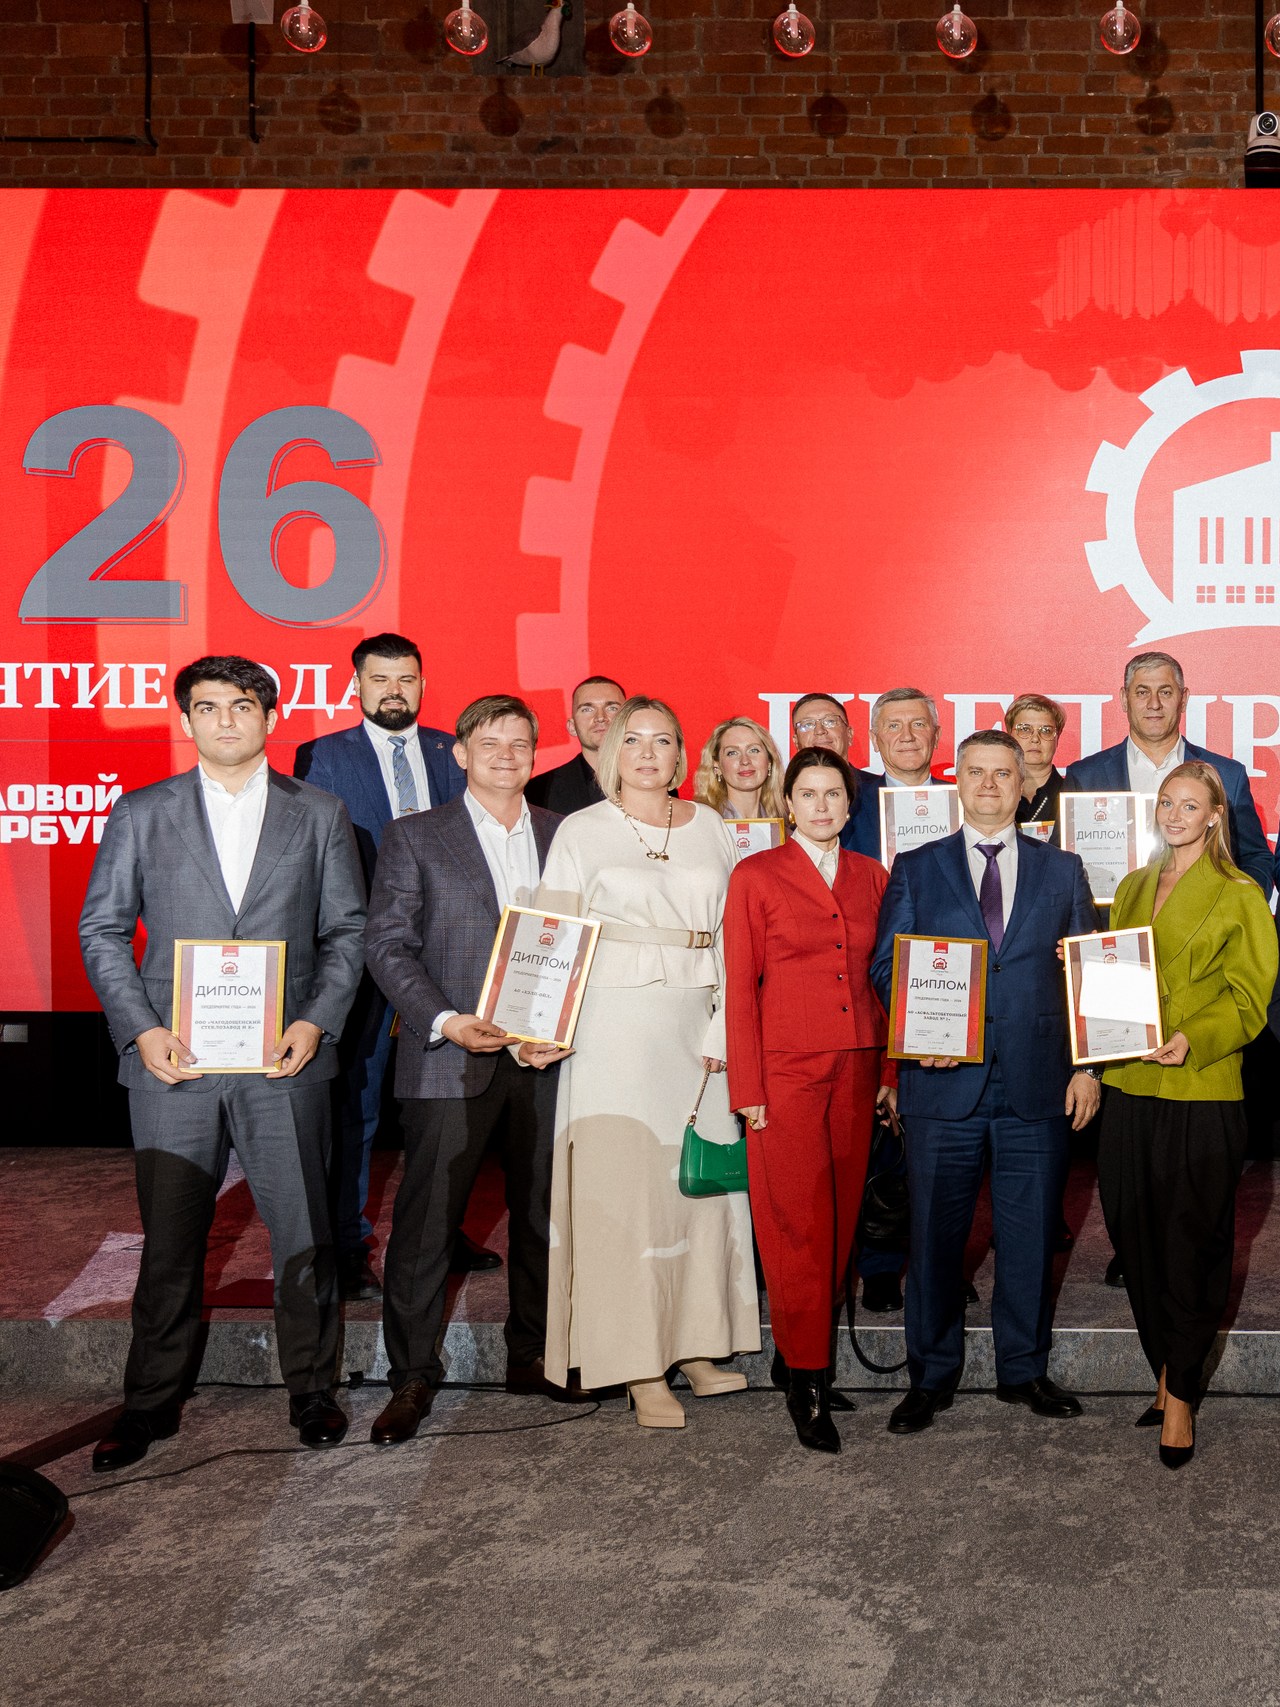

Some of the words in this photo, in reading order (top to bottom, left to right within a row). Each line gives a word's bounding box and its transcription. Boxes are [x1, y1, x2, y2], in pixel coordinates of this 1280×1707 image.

[18, 404, 388, 629] 26
[0, 773, 123, 812] ОВОЙ
[897, 825, 948, 836] ДИПЛОМ
[1076, 830, 1126, 841] ДИПЛОМ
[511, 951, 571, 971] ДИПЛОМ
[910, 978, 967, 991] ДИПЛОМ
[195, 985, 262, 998] ДИПЛОМ
